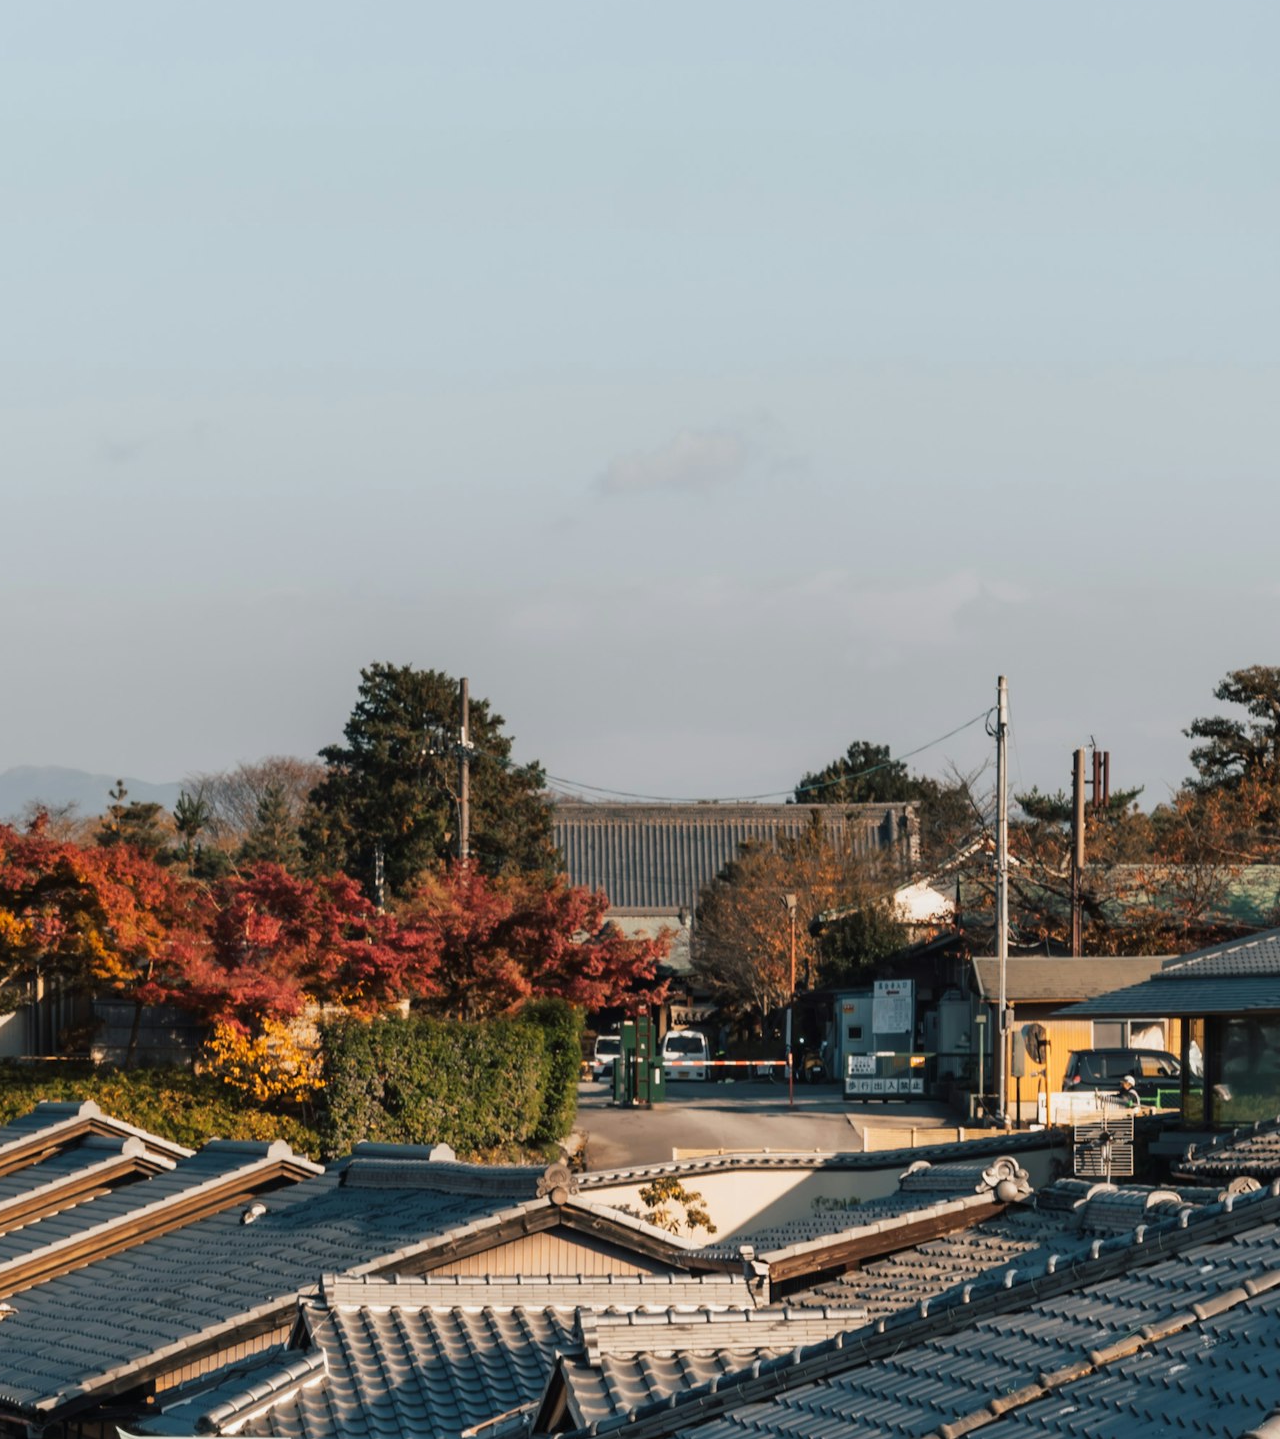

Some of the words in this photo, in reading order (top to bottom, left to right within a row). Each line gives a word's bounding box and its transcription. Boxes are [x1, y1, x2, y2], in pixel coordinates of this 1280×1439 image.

[848, 1081, 921, 1091] 歩行出入禁止
